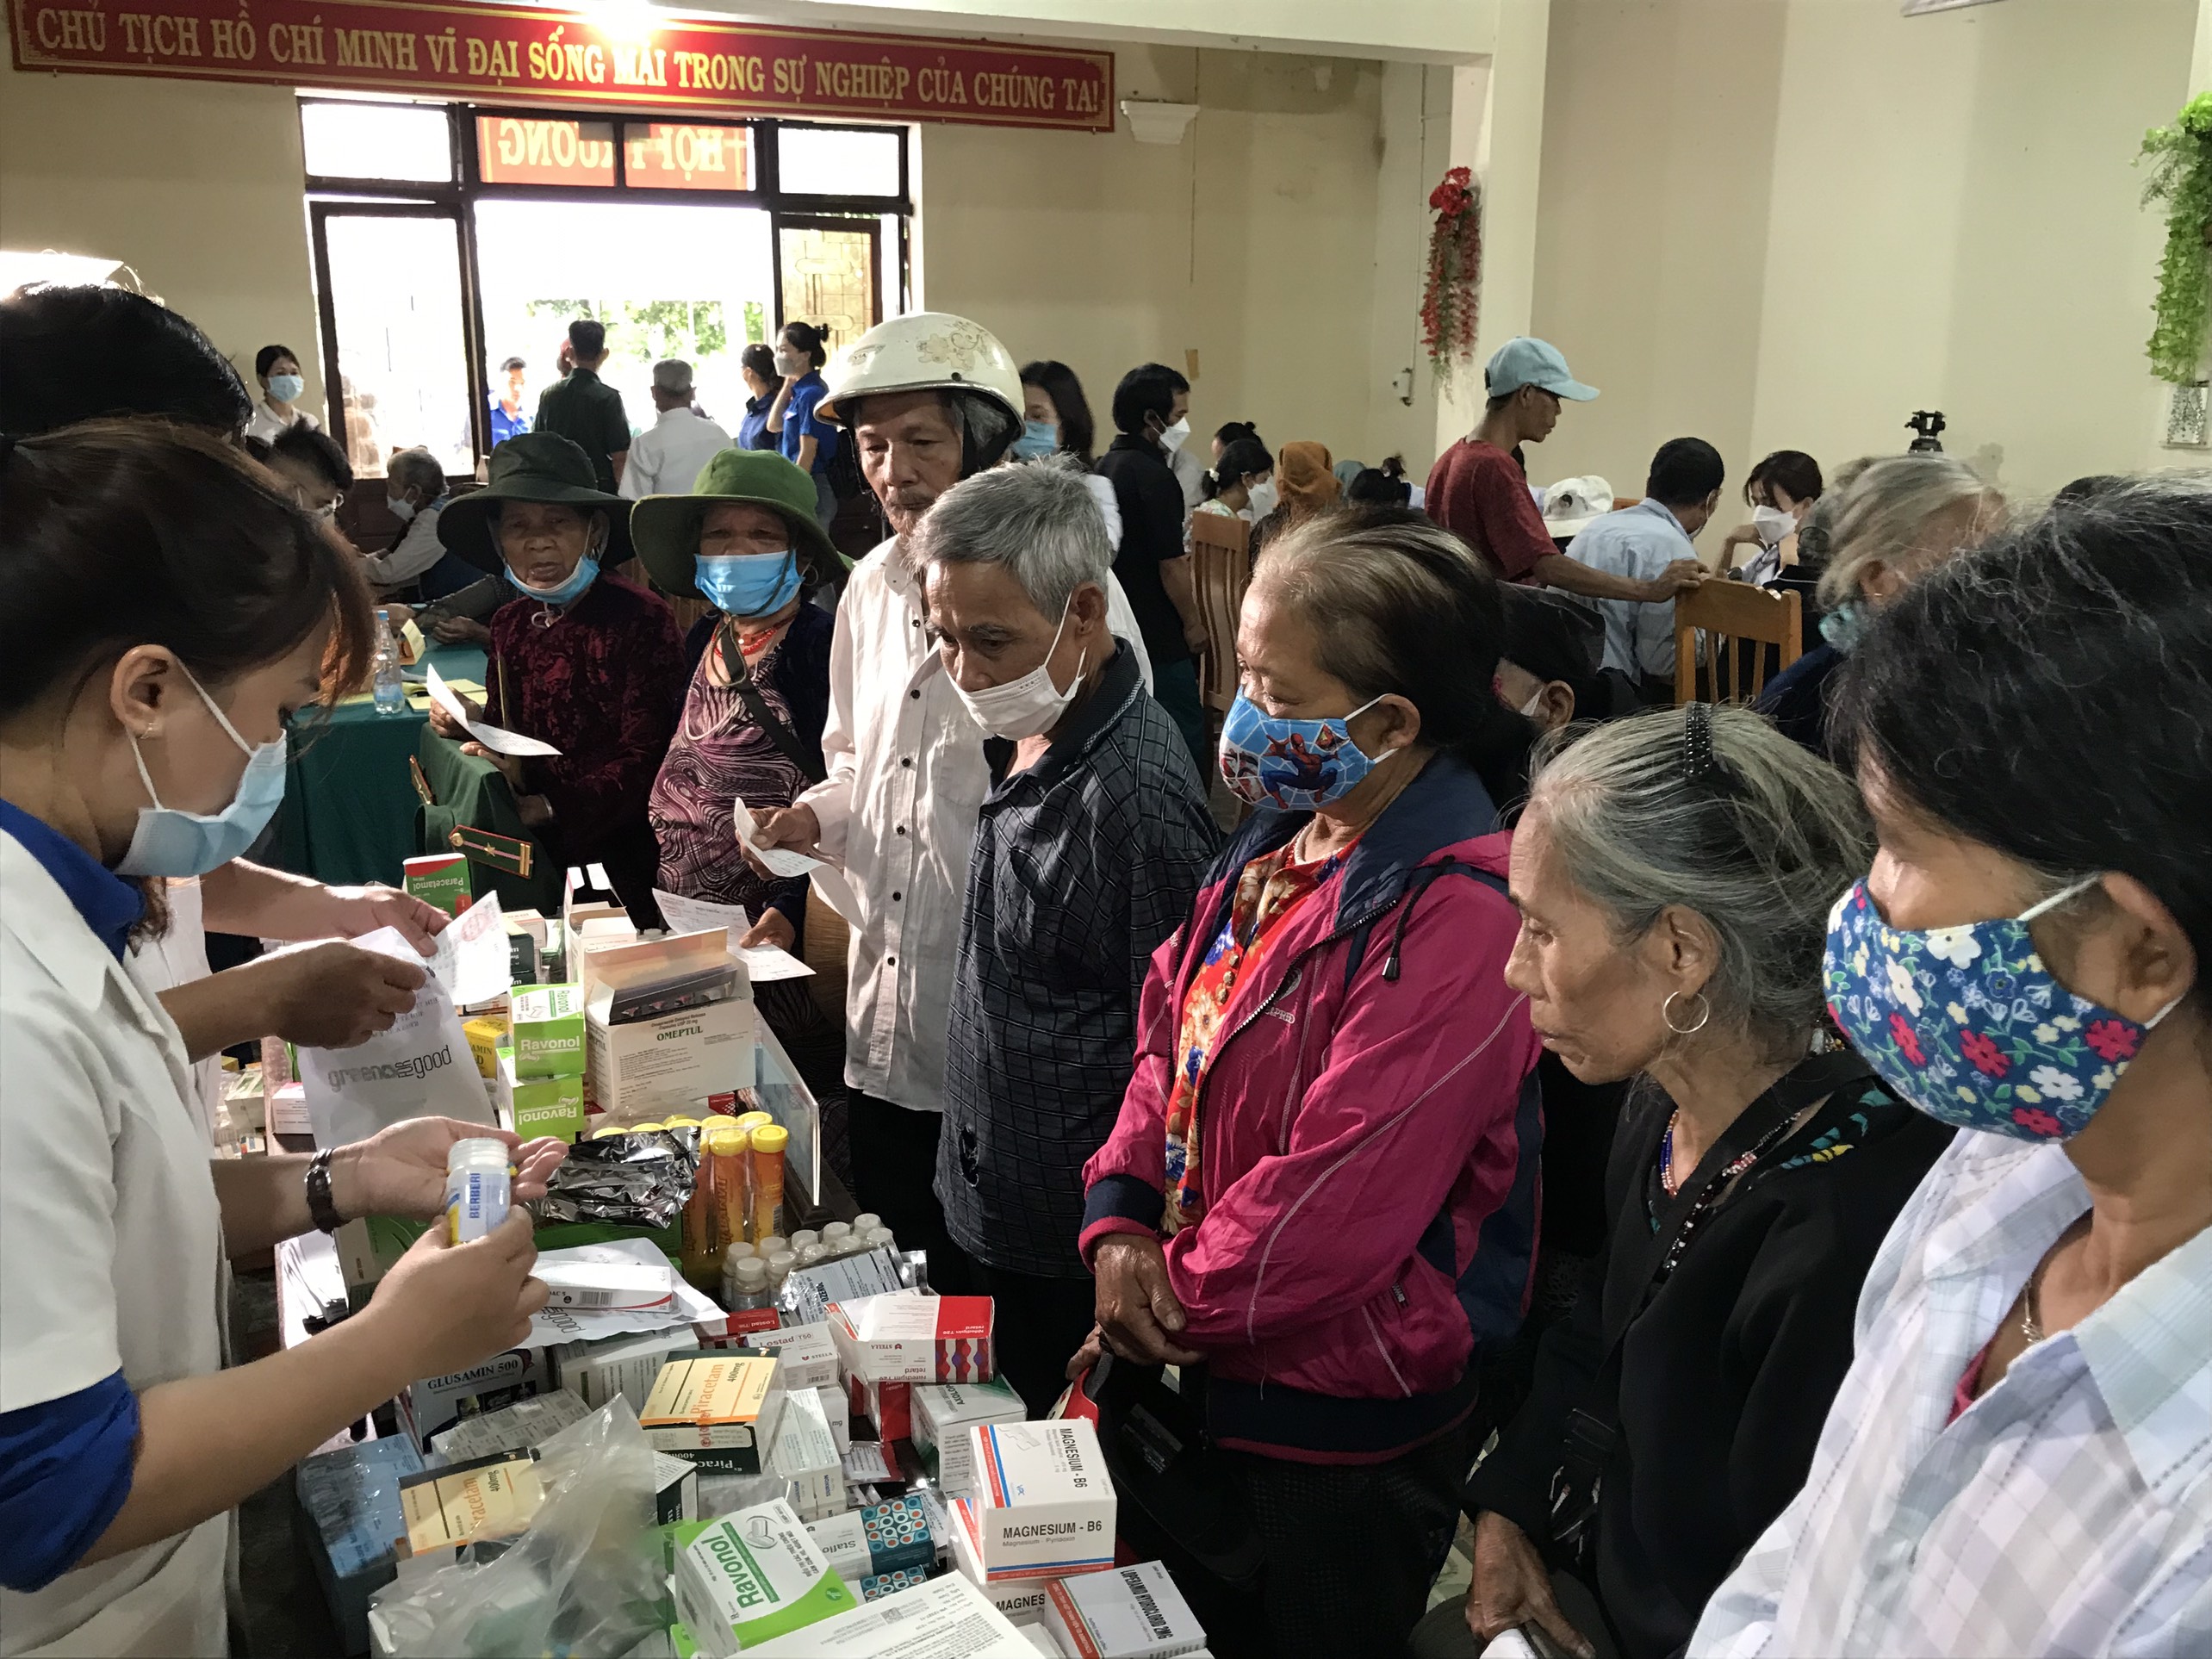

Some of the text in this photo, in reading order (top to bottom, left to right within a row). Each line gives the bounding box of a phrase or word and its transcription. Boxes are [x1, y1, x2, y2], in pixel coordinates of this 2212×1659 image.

[118, 13, 202, 64] TỊCH
[209, 0, 256, 60] HỒ
[269, 14, 326, 65] CHÍ
[334, 28, 419, 71] MINH
[425, 27, 458, 73] VĨ
[466, 38, 520, 85] ĐẠI
[528, 25, 606, 83] SỐNG
[674, 51, 765, 92] TRONG
[774, 53, 807, 103] SỰ
[815, 55, 910, 108] NGHIỆP
[917, 56, 967, 104] CỦA
[974, 65, 1055, 109] CHÚNG
[1062, 78, 1099, 112] TA!
[413, 877, 463, 892] Paracetamol
[558, 990, 572, 1013] Ravonol
[657, 1025, 703, 1041] OMEPTUL
[520, 1036, 581, 1052] Ravonol
[413, 1044, 451, 1079] good
[519, 1107, 577, 1125] Ravonol
[541, 1313, 586, 1334] good
[760, 1336, 794, 1347] Lostad
[811, 1351, 833, 1360] STELLA
[427, 1365, 494, 1390] GLUSAMIN
[498, 1358, 519, 1372] 500
[690, 1362, 745, 1414] Piracetam 400mg
[697, 1459, 734, 1469] Pirac
[1059, 1427, 1084, 1472] MAGNESIUM
[1073, 1477, 1088, 1488] B6
[488, 1469, 500, 1492] 400mg
[1003, 1522, 1076, 1539] MAGNESIUM
[1087, 1520, 1103, 1532] B6
[1003, 1538, 1040, 1547] Magnesium
[700, 1534, 765, 1609] Ravonol
[996, 1593, 1045, 1612] MAGNES
[1153, 1625, 1174, 1640] 2MG
